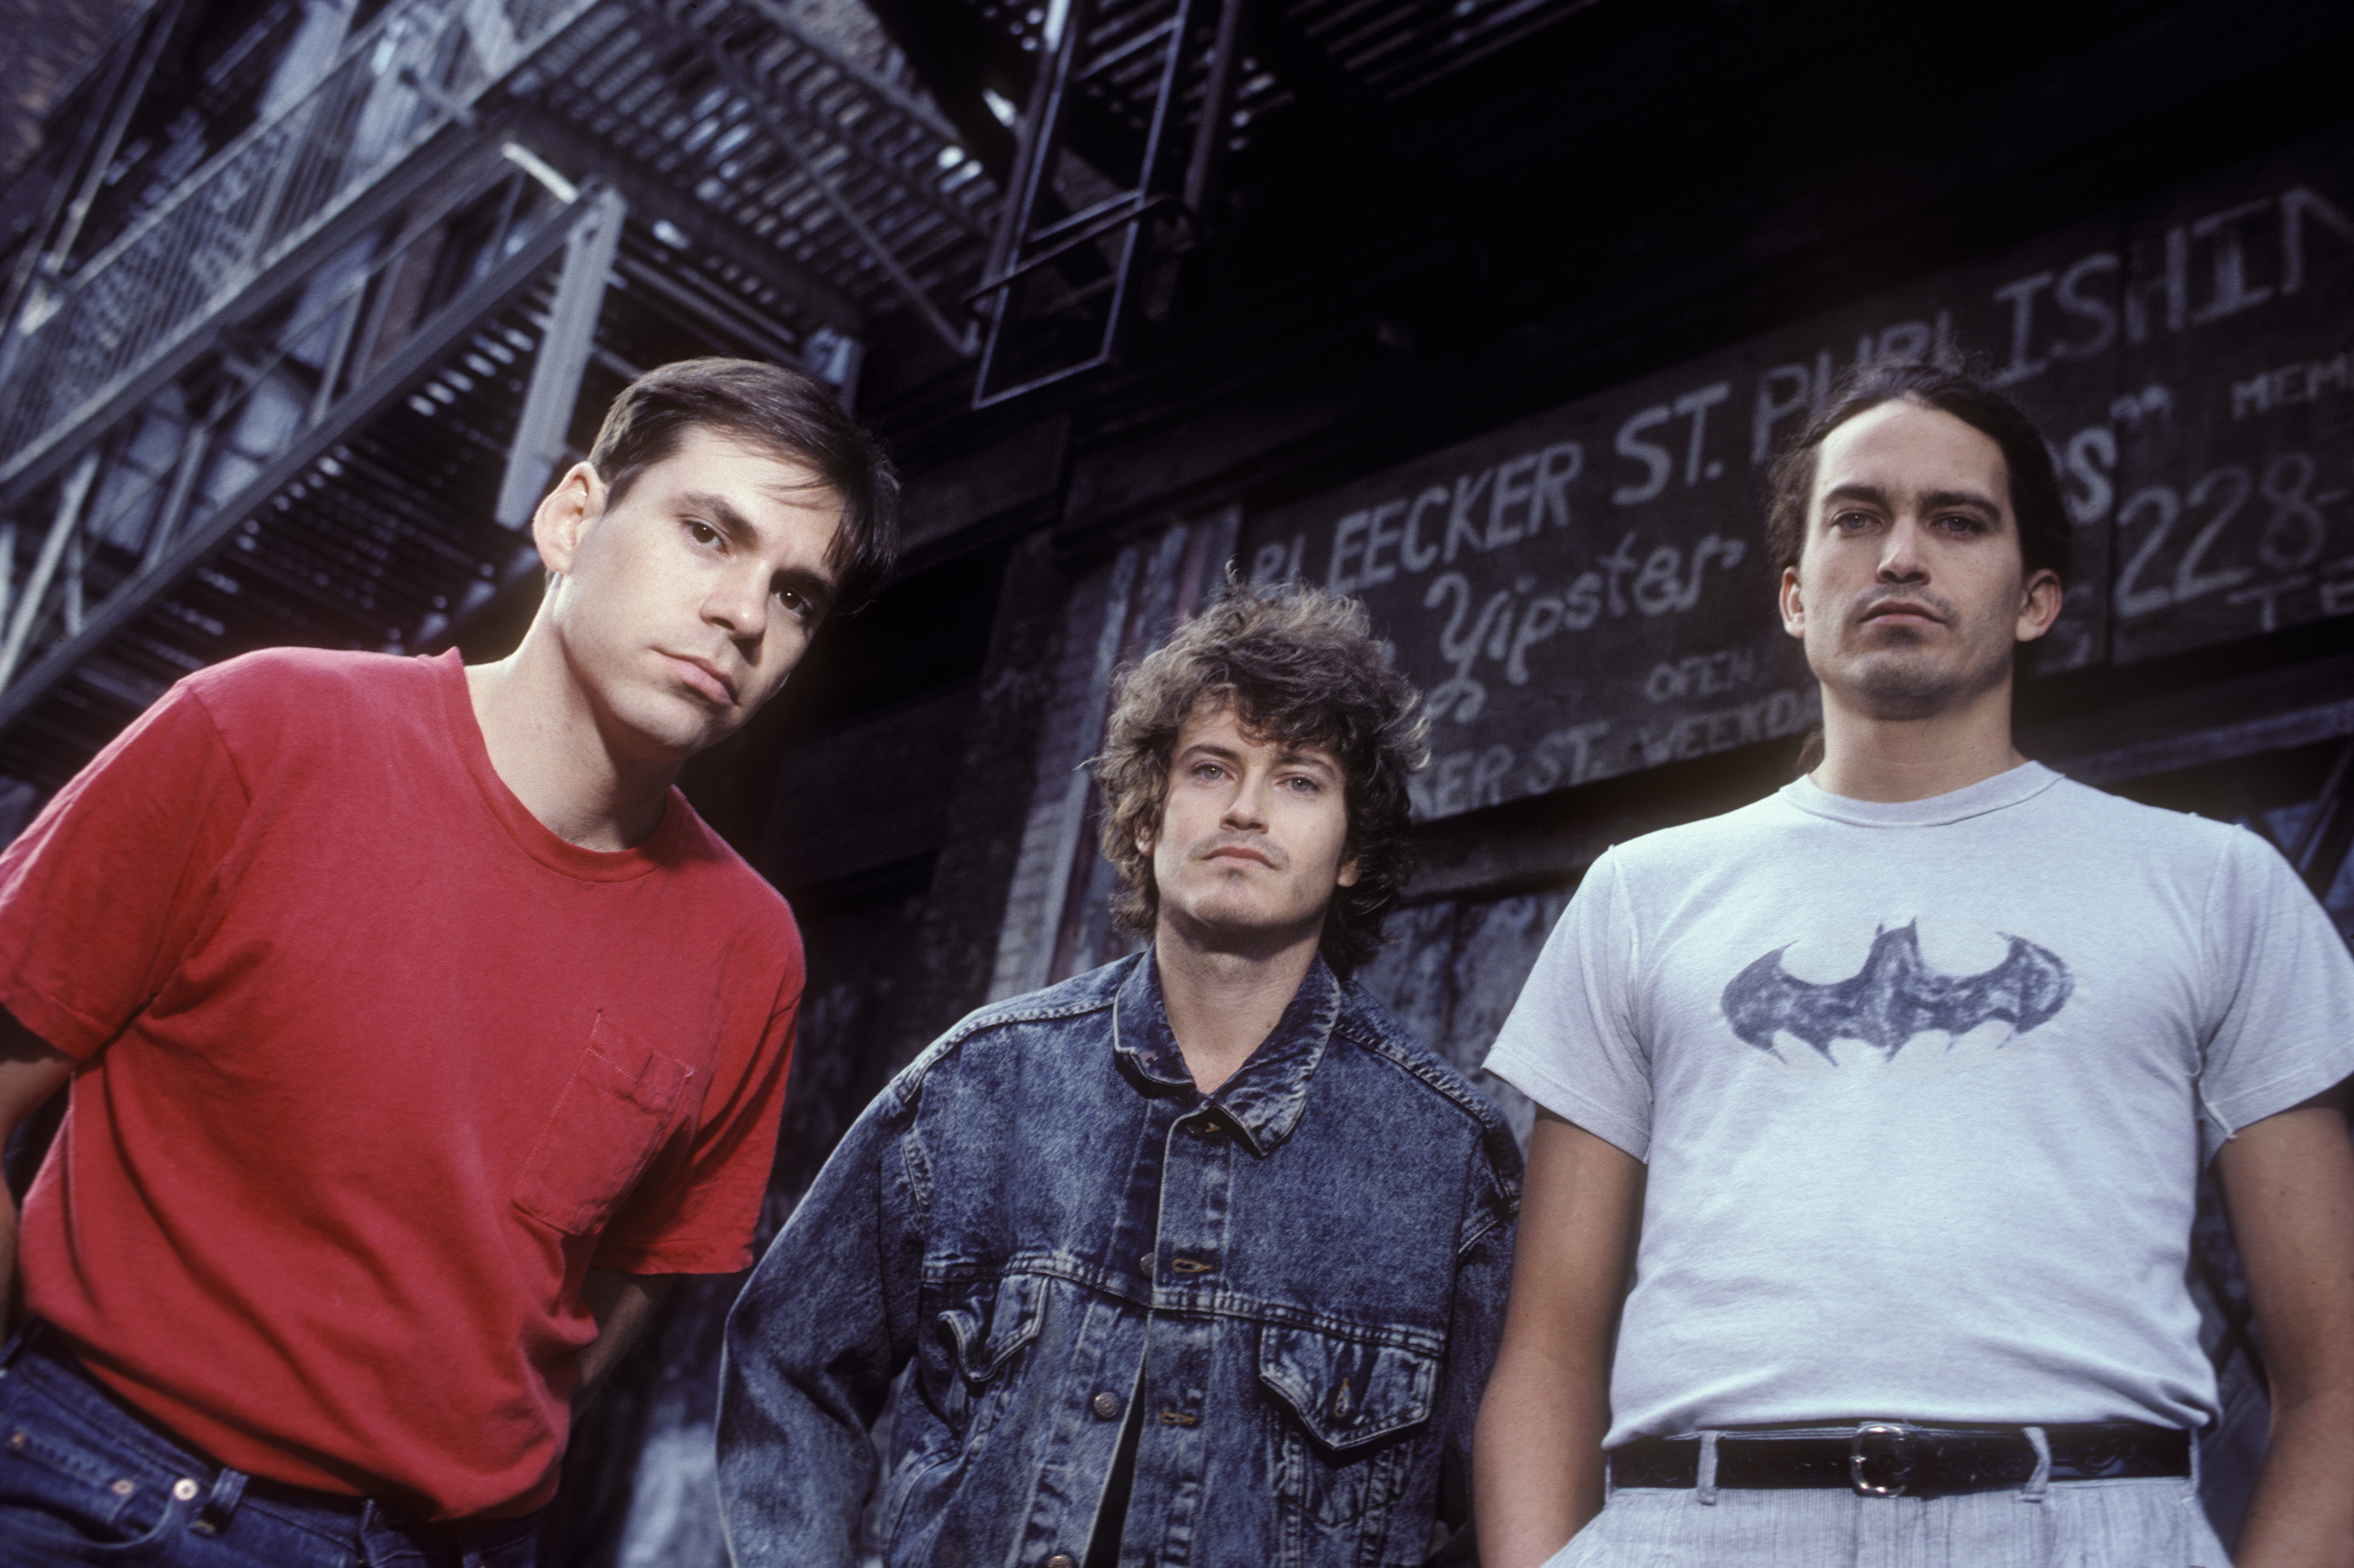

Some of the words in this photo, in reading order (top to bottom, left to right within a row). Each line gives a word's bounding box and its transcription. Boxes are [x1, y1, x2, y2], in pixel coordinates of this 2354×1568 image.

[1612, 380, 1730, 506] ST.
[1419, 531, 1747, 723] Yipster
[1643, 648, 1754, 703] OPEN
